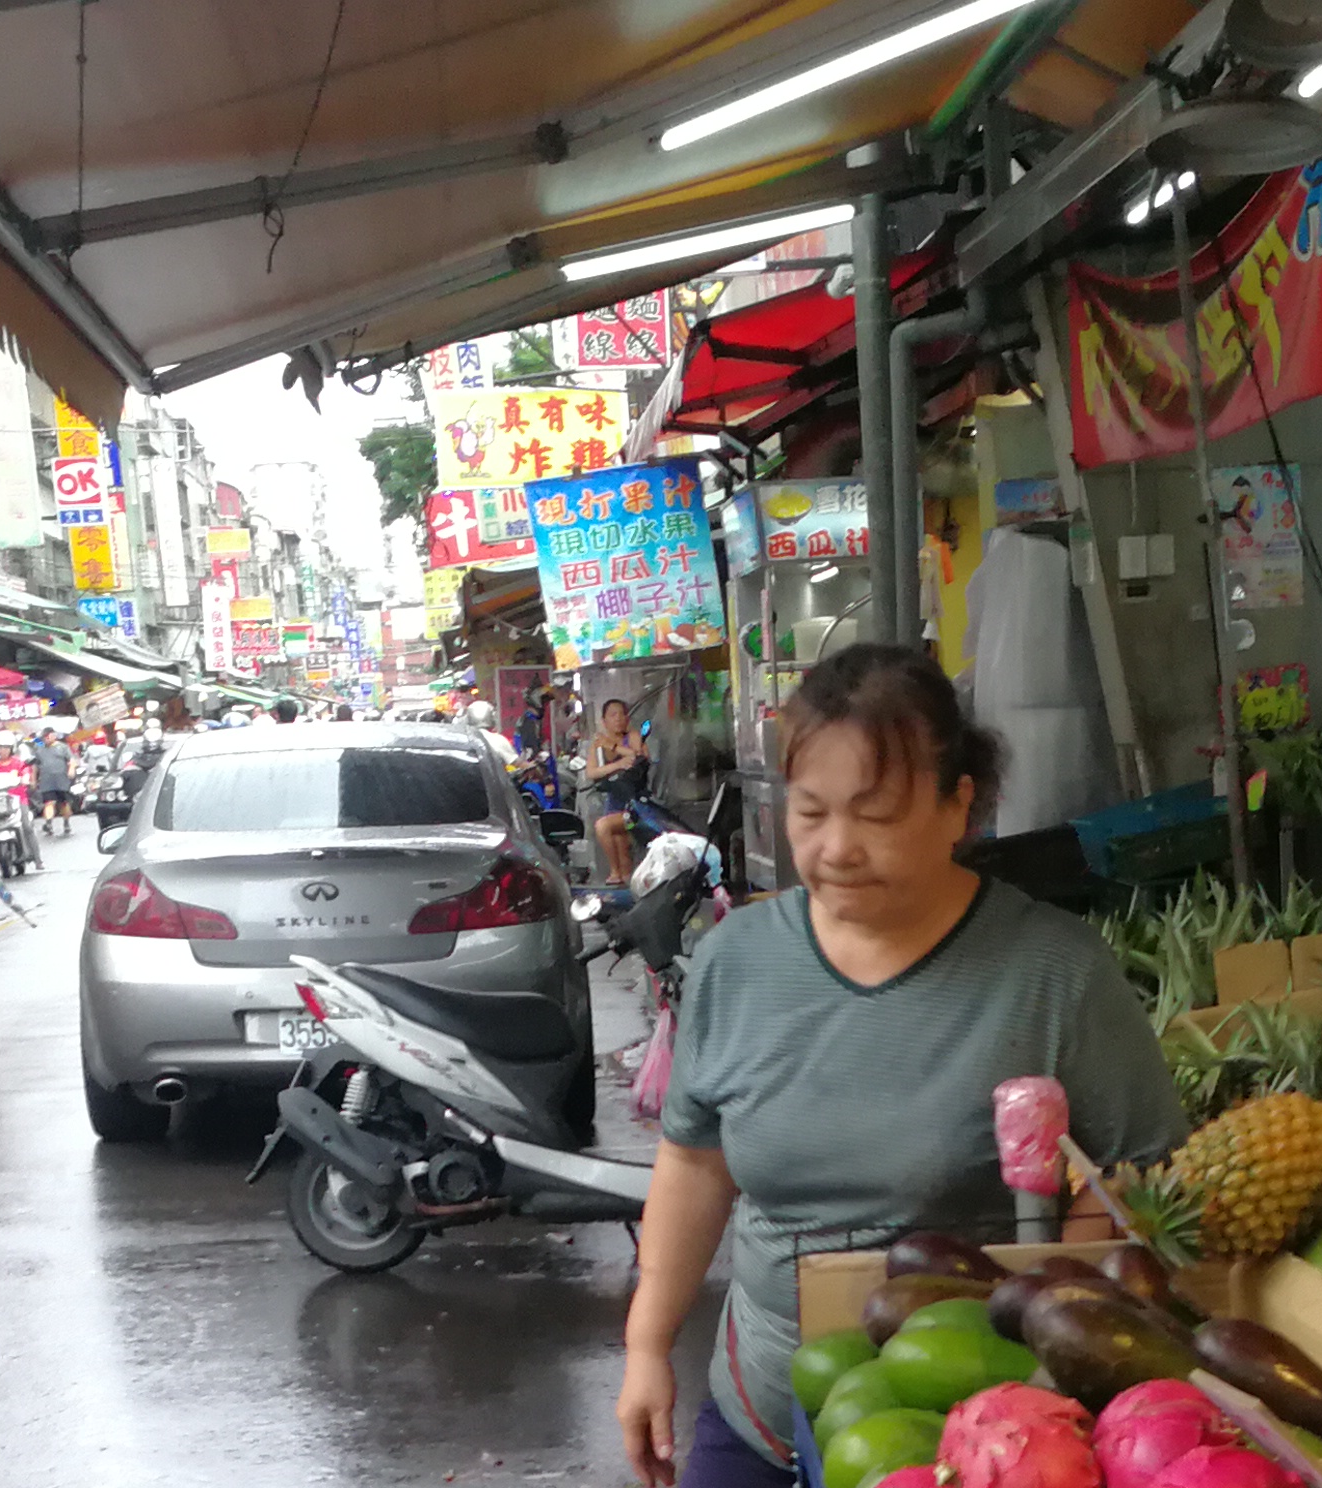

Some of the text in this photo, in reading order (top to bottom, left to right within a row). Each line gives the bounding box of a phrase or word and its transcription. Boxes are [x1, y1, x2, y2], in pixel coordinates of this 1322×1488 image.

[498, 393, 616, 435] 真有味
[509, 438, 613, 479] 炸雞
[56, 466, 100, 496] OK
[535, 473, 698, 526] 現打果汁
[550, 511, 698, 556] 現切水果
[766, 526, 870, 559] 西瓜汁
[559, 542, 700, 592] 西瓜汁
[595, 575, 714, 620] 椰子汁
[275, 914, 371, 928] SKYLINE
